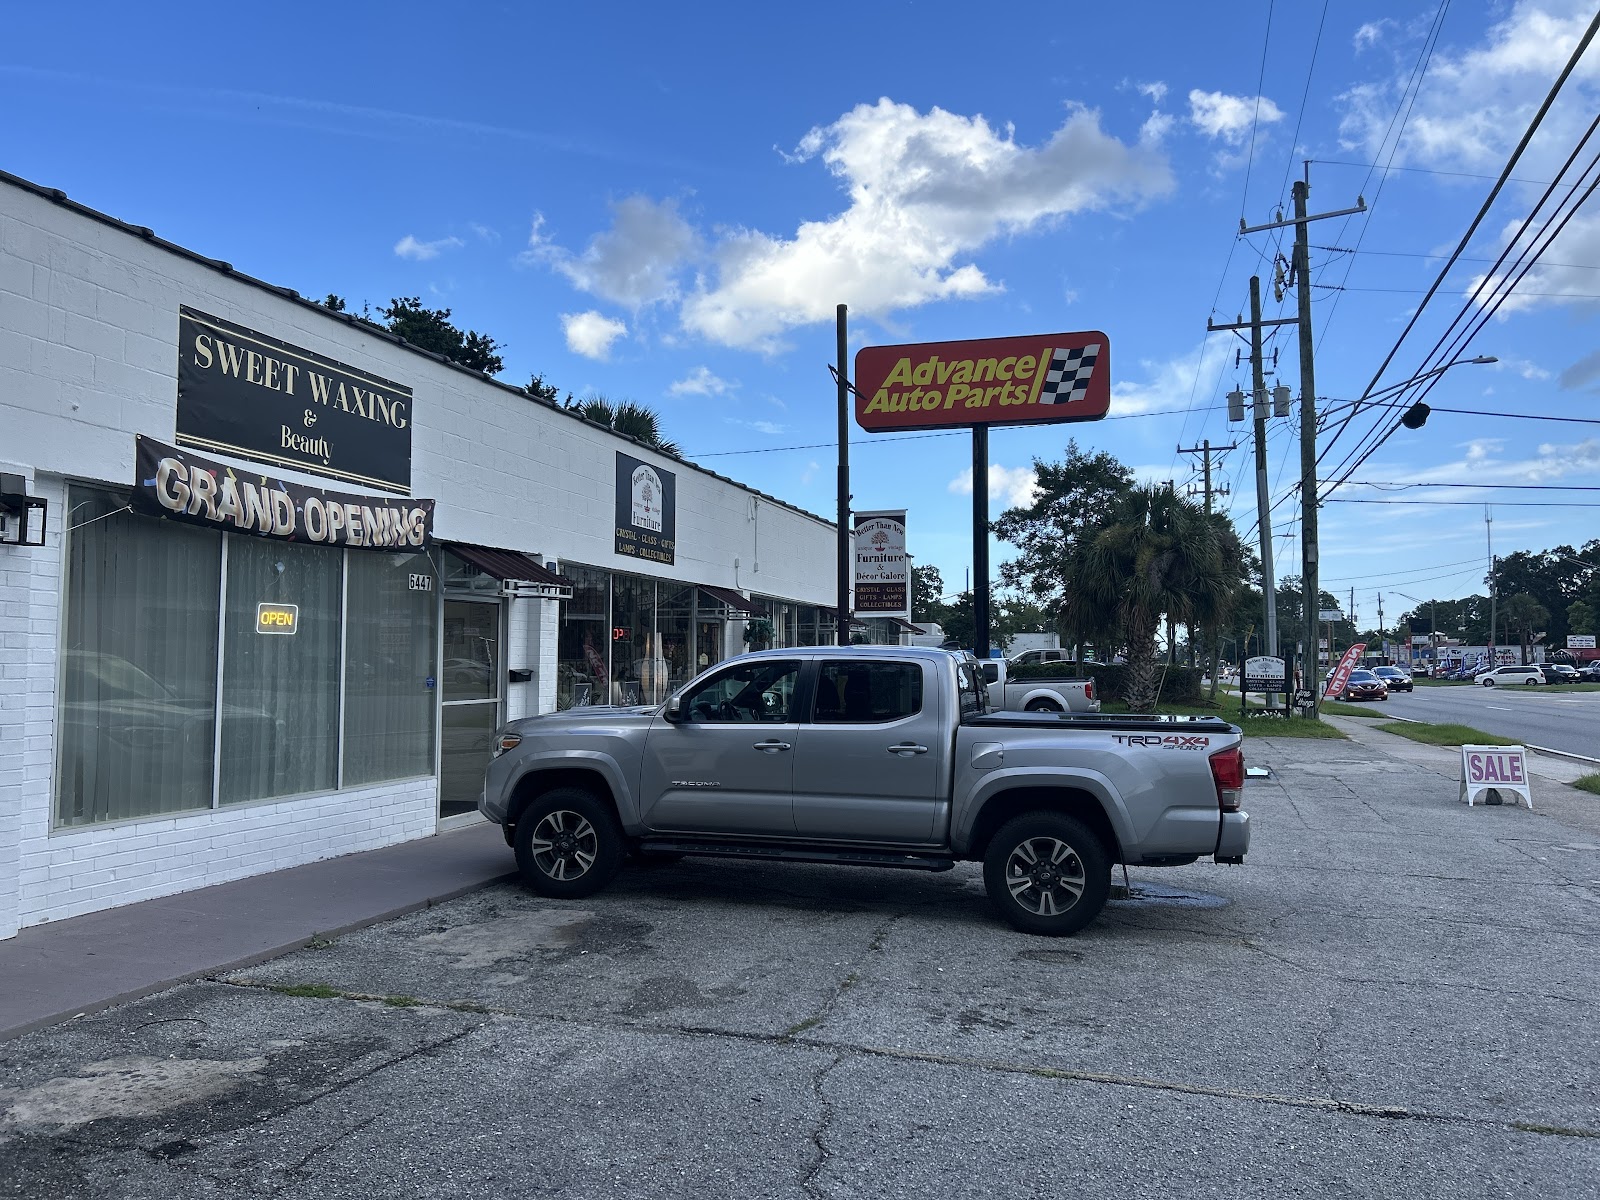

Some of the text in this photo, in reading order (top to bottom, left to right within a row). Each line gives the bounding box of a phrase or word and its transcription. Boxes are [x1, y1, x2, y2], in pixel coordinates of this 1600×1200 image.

[881, 354, 1036, 388] Advance
[194, 334, 407, 429] SWEET WAXING
[863, 381, 1030, 414] Auto Parts
[303, 408, 318, 428] &
[280, 424, 334, 466] Beauty
[156, 457, 426, 547] GRAND OPENING
[632, 510, 661, 531] Furniture
[856, 522, 904, 536] Better Than New
[616, 528, 675, 550] CRYSTAL GLASS GIFTS
[618, 543, 672, 562] LAMPS COLLECTIBLES
[857, 553, 904, 563] Furniture
[410, 574, 431, 590] 6447
[856, 572, 905, 580] Décor Galore
[261, 612, 293, 626] OPEN
[1330, 648, 1361, 692] SALE
[1298, 698, 1314, 708] things
[1112, 735, 1210, 748] TRD 4X4
[1470, 754, 1522, 781] SALE
